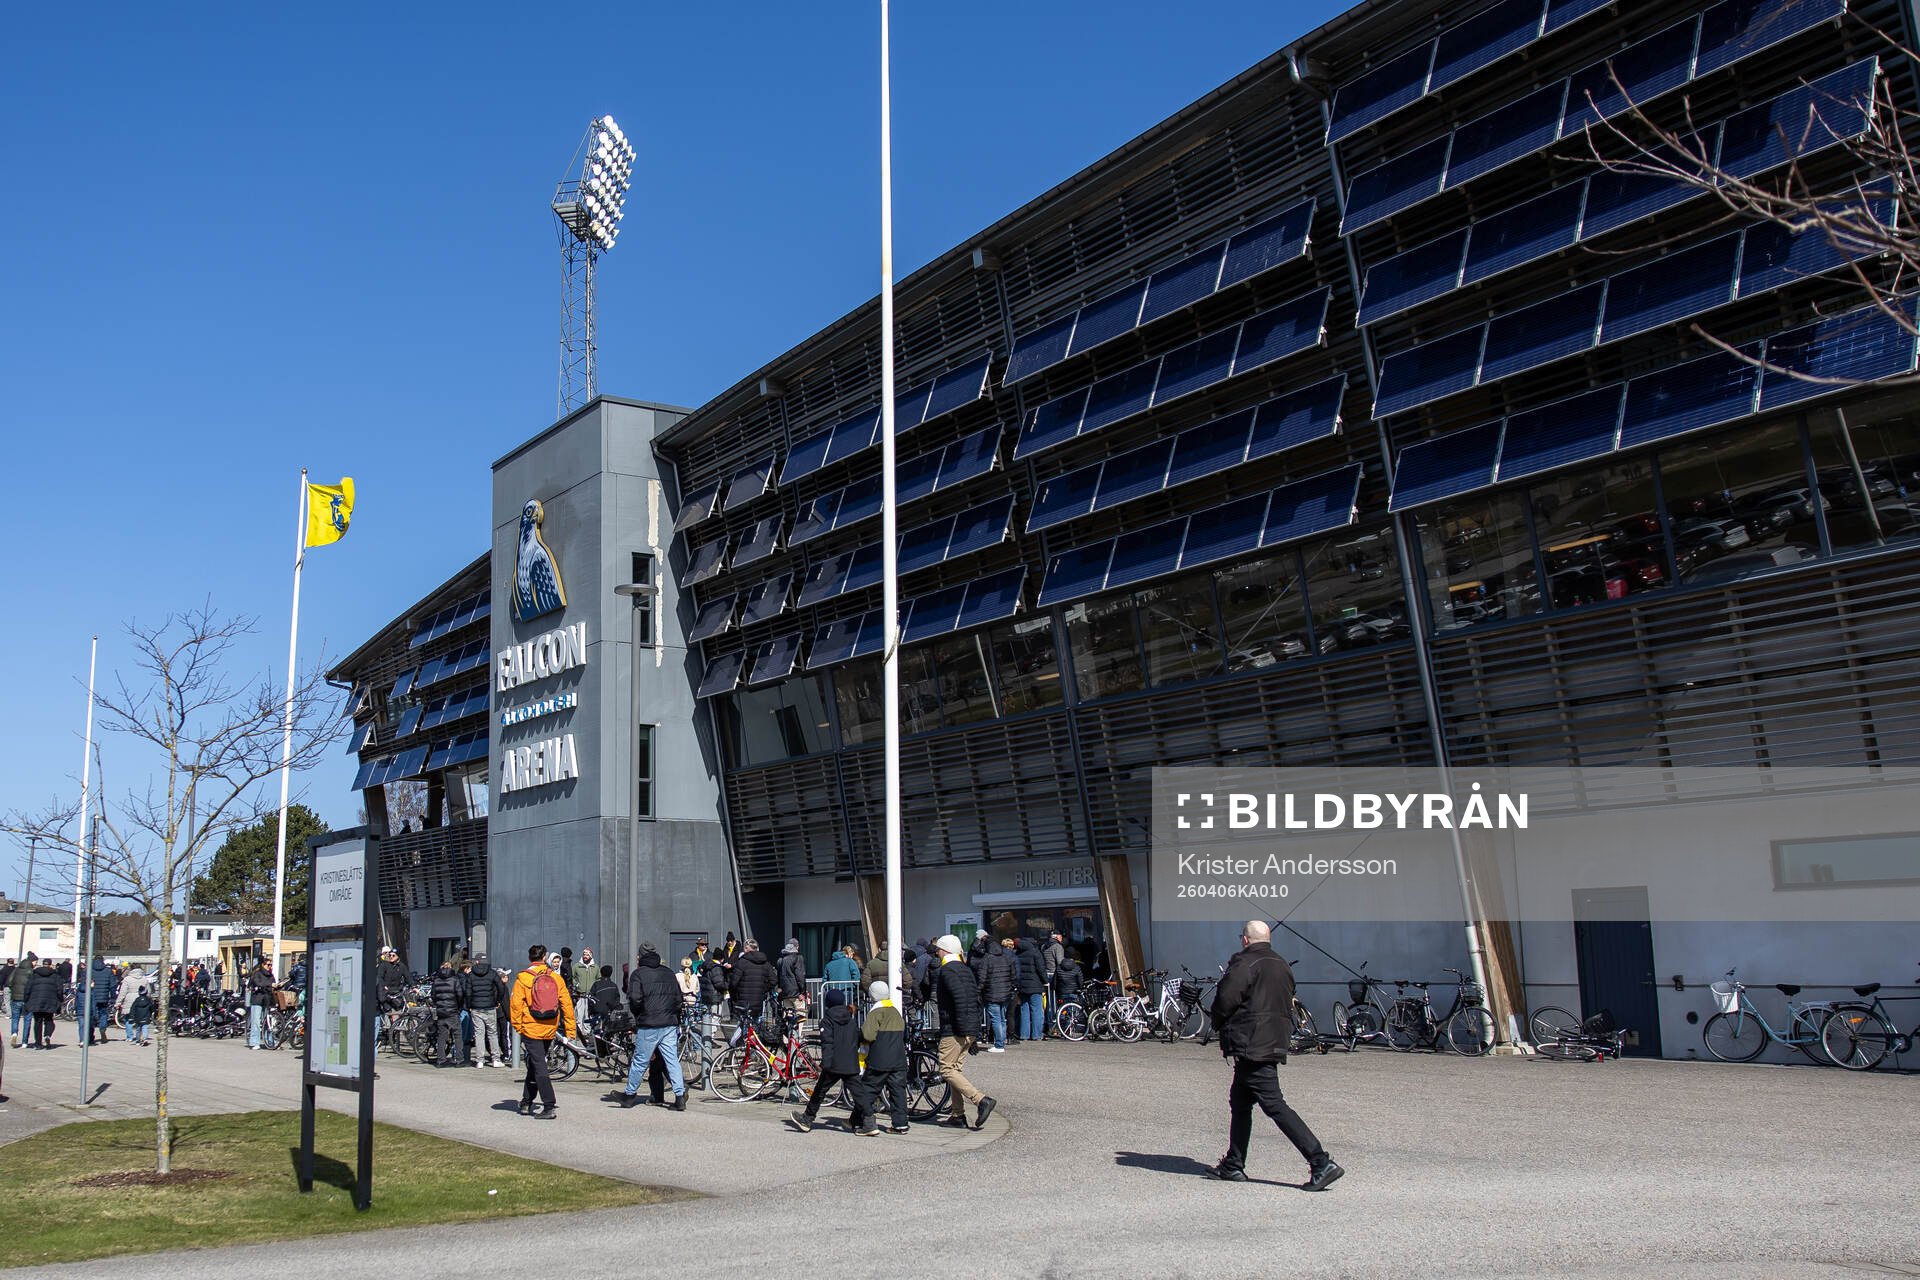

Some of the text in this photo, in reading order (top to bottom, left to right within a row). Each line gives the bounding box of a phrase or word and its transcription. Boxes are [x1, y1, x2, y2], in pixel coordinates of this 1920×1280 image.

[497, 621, 587, 692] FALCON
[501, 734, 579, 793] ARENA
[329, 885, 352, 902] OMRÅDE
[1015, 866, 1096, 889] BILJETTER
